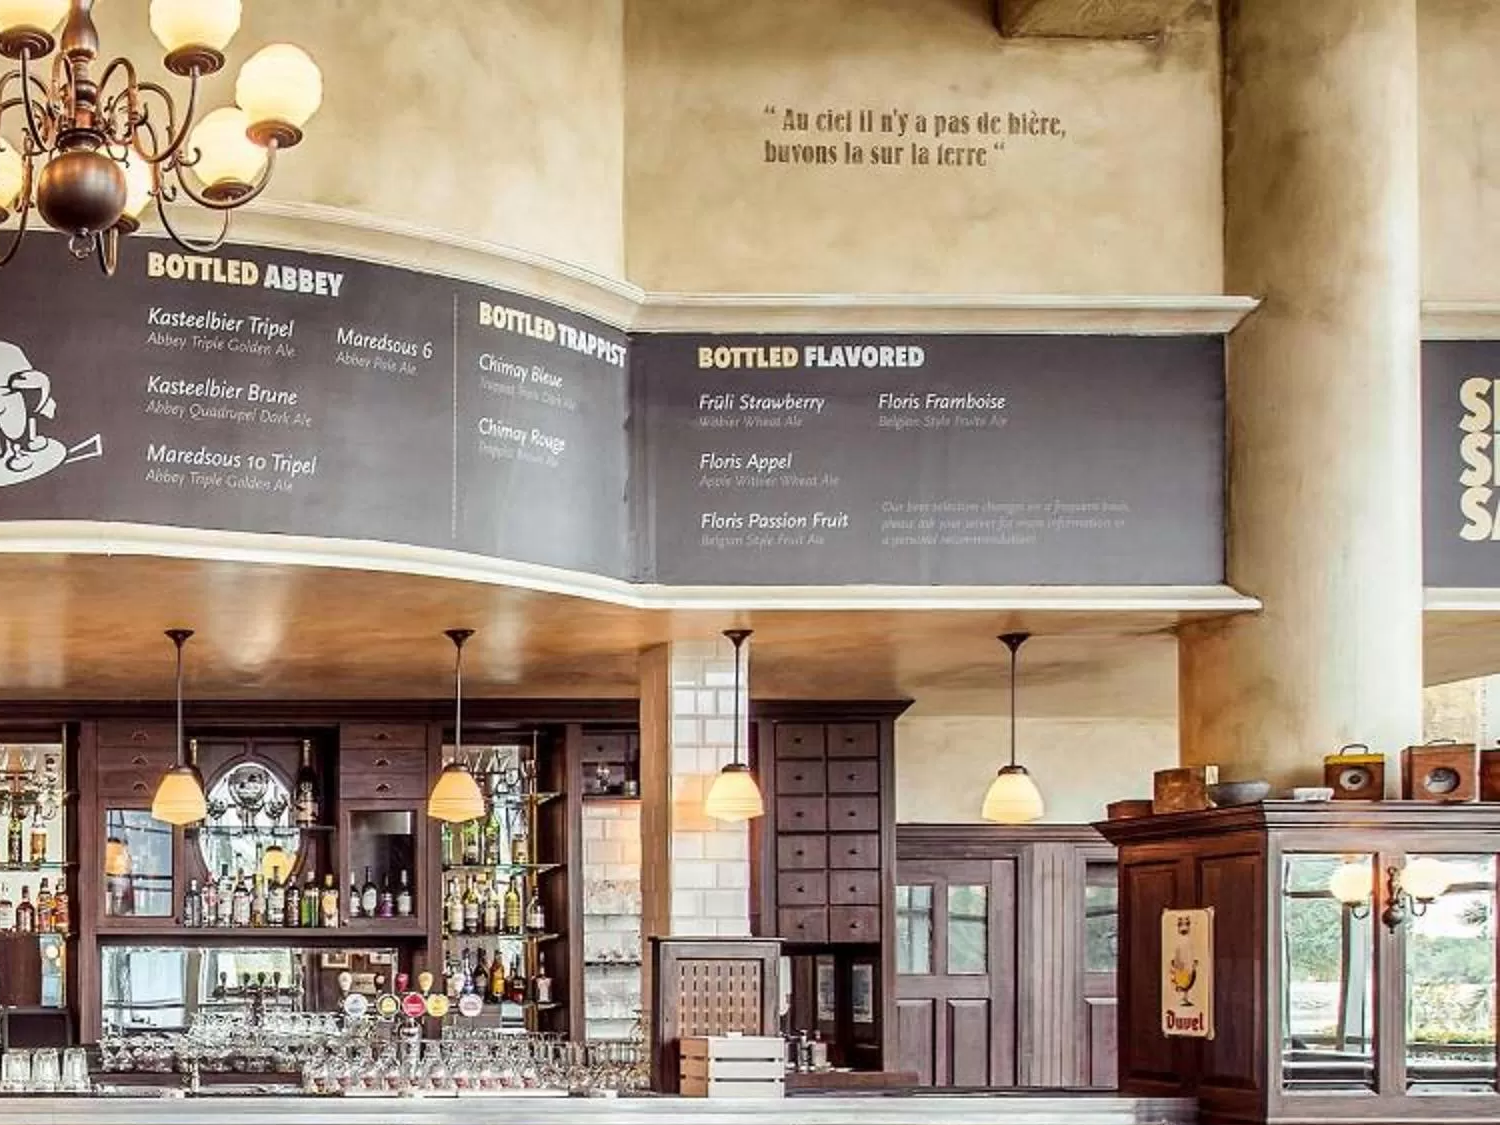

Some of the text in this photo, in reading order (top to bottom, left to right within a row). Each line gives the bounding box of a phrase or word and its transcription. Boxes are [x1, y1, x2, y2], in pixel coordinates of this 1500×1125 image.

[782, 109, 809, 131] Au
[816, 109, 852, 132] ciel
[915, 114, 927, 133] a
[935, 113, 970, 137] pas
[977, 111, 1001, 134] de
[764, 140, 838, 164] buvons
[844, 142, 863, 165] la
[870, 144, 904, 165] sur
[911, 142, 930, 166] la
[936, 143, 987, 166] terre
[148, 252, 344, 297] BOTTLED ABBEY
[147, 308, 293, 338] Kasteelbier Tripel
[479, 302, 626, 368] BOTTLED TRAPPIST
[147, 333, 295, 358] Abbey Triple Golden Ale
[337, 328, 432, 359] Maredsous 6
[479, 354, 527, 383] Chimay
[699, 347, 925, 368] BOTTLED FLAVORED
[147, 376, 297, 404] Kasteelbier Brune
[879, 393, 1006, 410] Floris Framboise
[146, 402, 185, 419] Abbey
[293, 413, 312, 428] Ale
[740, 393, 824, 414] Strawberry
[479, 418, 527, 447] Chimay
[147, 445, 316, 476] Maredsous 10 Tripel
[701, 453, 792, 473] Floris Appel
[274, 478, 292, 492] Ale
[701, 512, 848, 529] Floris Passion Fruit
[1167, 1010, 1204, 1031] Duvel
